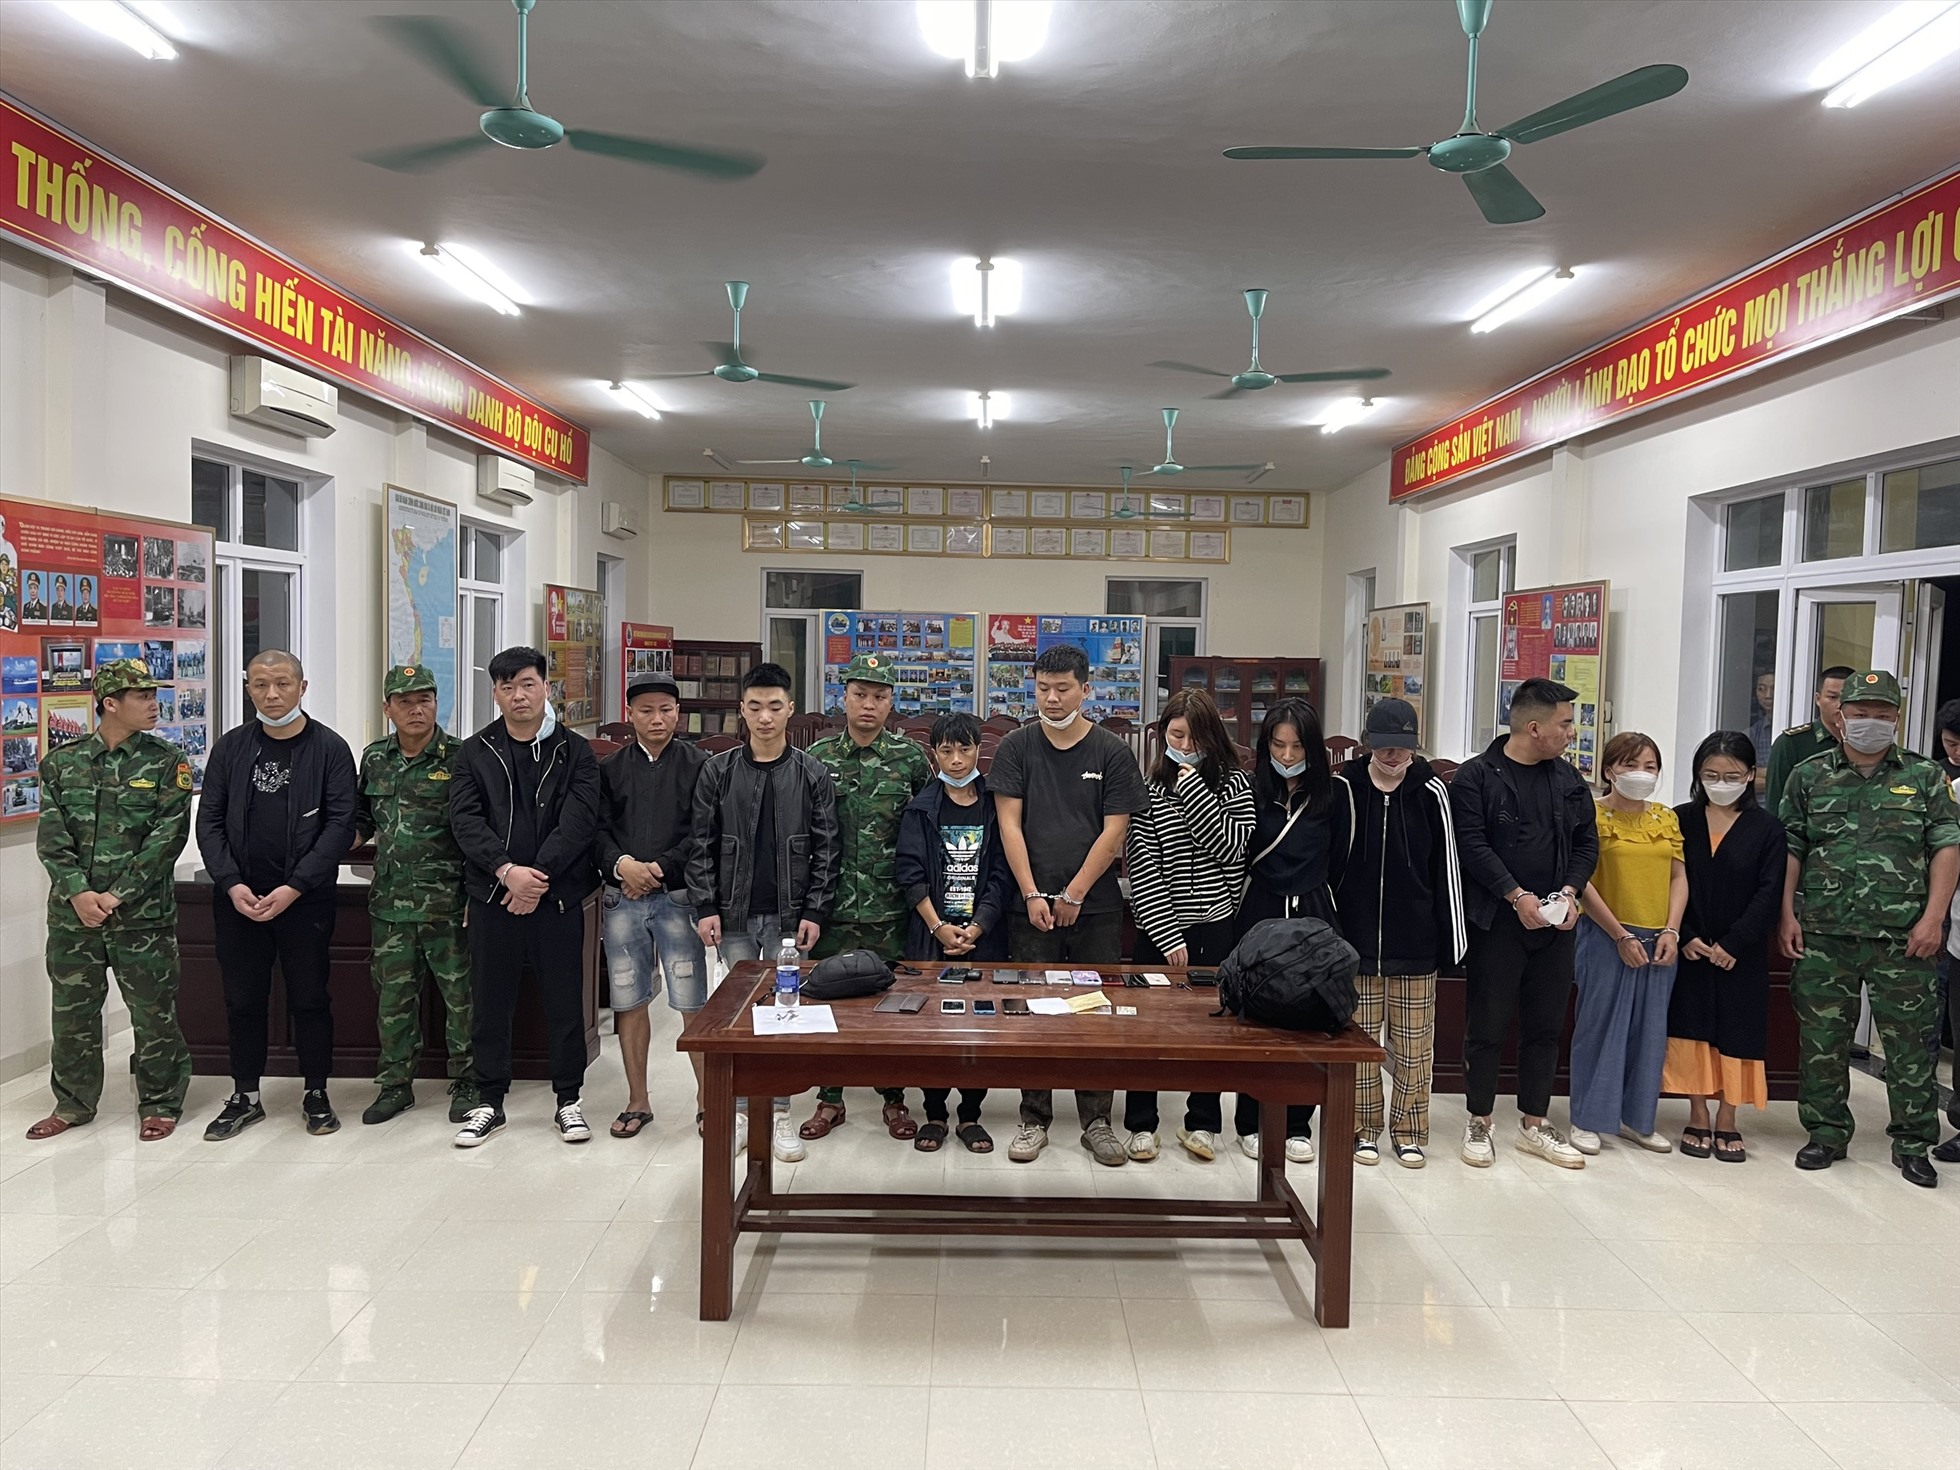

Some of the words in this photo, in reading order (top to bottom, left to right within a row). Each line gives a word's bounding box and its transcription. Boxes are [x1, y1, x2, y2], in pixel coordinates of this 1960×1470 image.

[11, 141, 154, 273] THỐNG,
[164, 223, 247, 312] CỐNG
[255, 272, 314, 345] HIẾN
[320, 306, 354, 364] TÀI
[467, 386, 503, 434] DANH
[505, 404, 522, 448] BỘ
[523, 412, 543, 456] ĐỘI
[544, 426, 558, 464] CỤ
[560, 429, 573, 465] HỔ
[1404, 447, 1426, 486] ĐẢNG
[1427, 439, 1450, 480] CỘNG
[1451, 423, 1471, 467] SẢN
[1473, 415, 1494, 461] VIỆT
[1495, 407, 1522, 449] NAM
[1574, 364, 1613, 414] LÃNH
[1616, 348, 1650, 404] ĐẠO
[1655, 317, 1680, 385] TỔ
[1681, 305, 1737, 373] CHỨC
[1742, 283, 1789, 349] MỌI
[1797, 238, 1886, 326] THẮNG
[1894, 210, 1944, 292] LỢI
[946, 863, 979, 872] adidas
